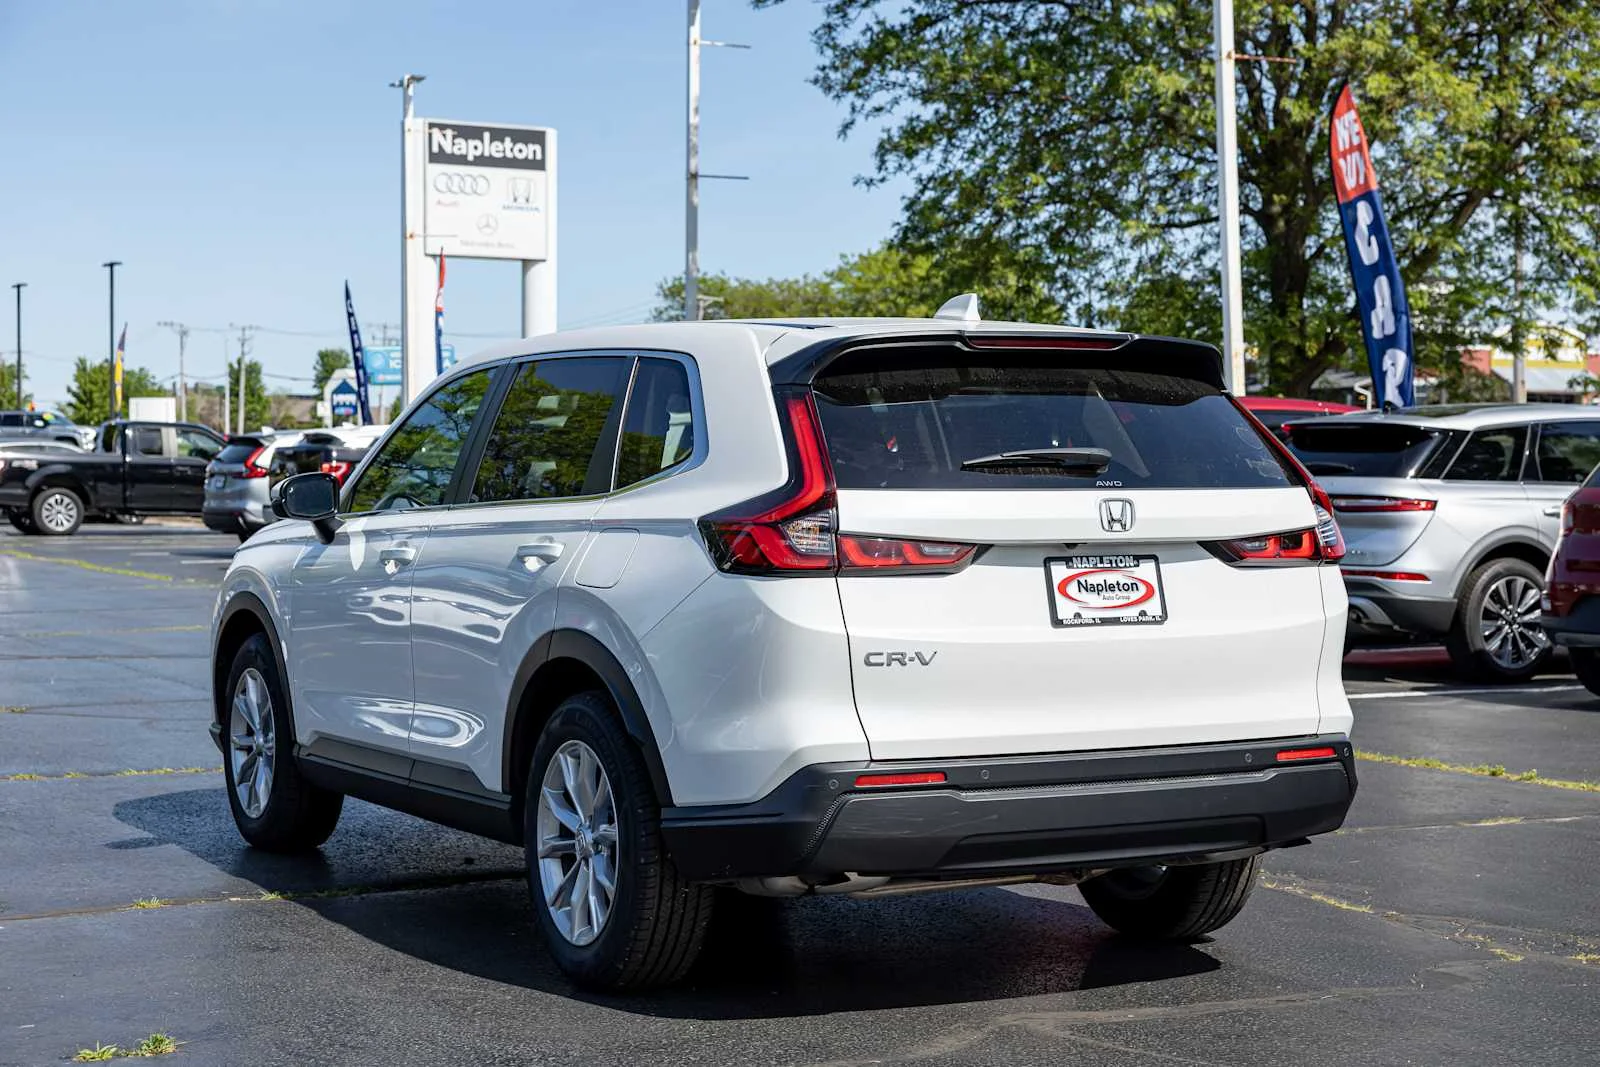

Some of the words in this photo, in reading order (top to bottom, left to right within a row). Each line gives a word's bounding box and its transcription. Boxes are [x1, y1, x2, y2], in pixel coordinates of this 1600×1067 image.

[1334, 109, 1361, 152] WE
[431, 127, 542, 161] Napleton
[1072, 555, 1135, 568] NAPLETON
[1077, 579, 1139, 596] Napleton
[864, 651, 937, 667] CR-V
